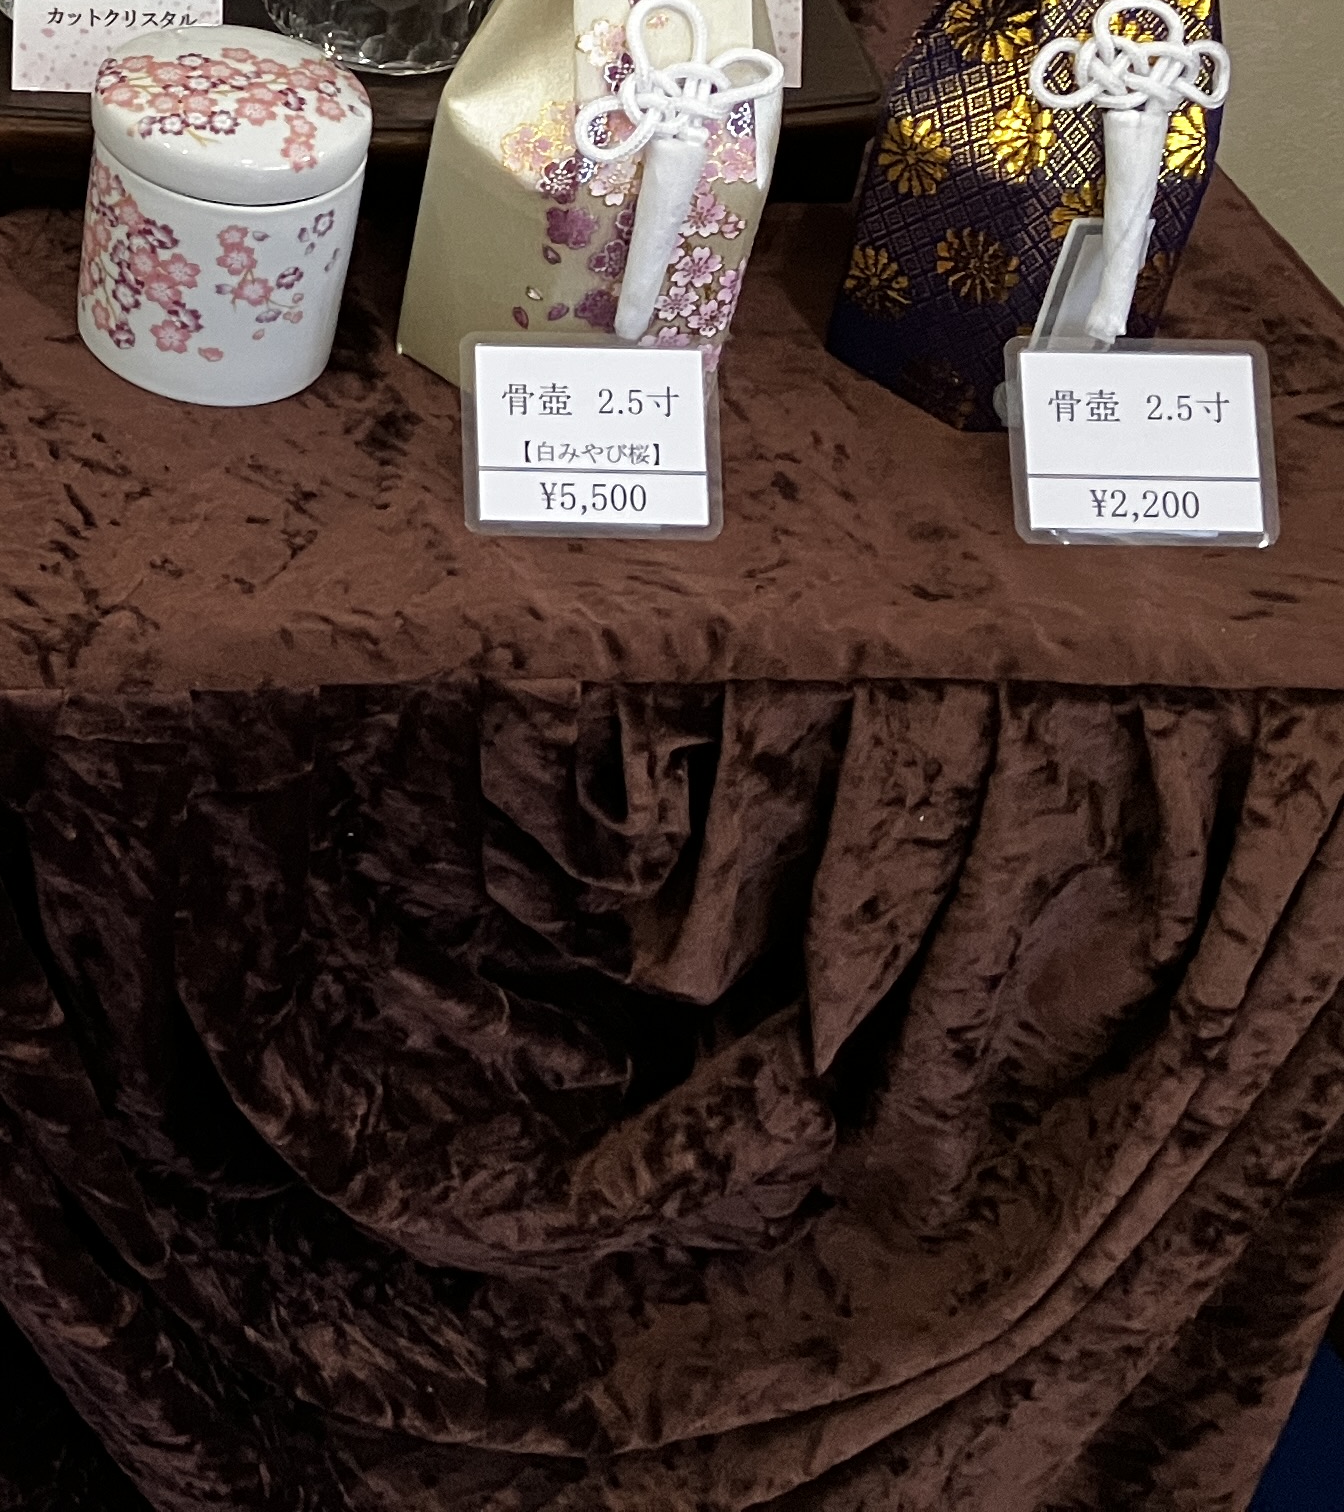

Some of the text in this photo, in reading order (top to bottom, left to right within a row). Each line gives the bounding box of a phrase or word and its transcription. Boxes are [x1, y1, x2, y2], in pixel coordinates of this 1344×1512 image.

[47, 8, 199, 28] カットクリスタル
[598, 386, 680, 418] 2.5寸
[1146, 391, 1230, 424] 2.5寸
[524, 440, 661, 466] 【白みやび桜】
[539, 482, 648, 516] ¥5,500
[1089, 489, 1200, 523] ¥2,200
